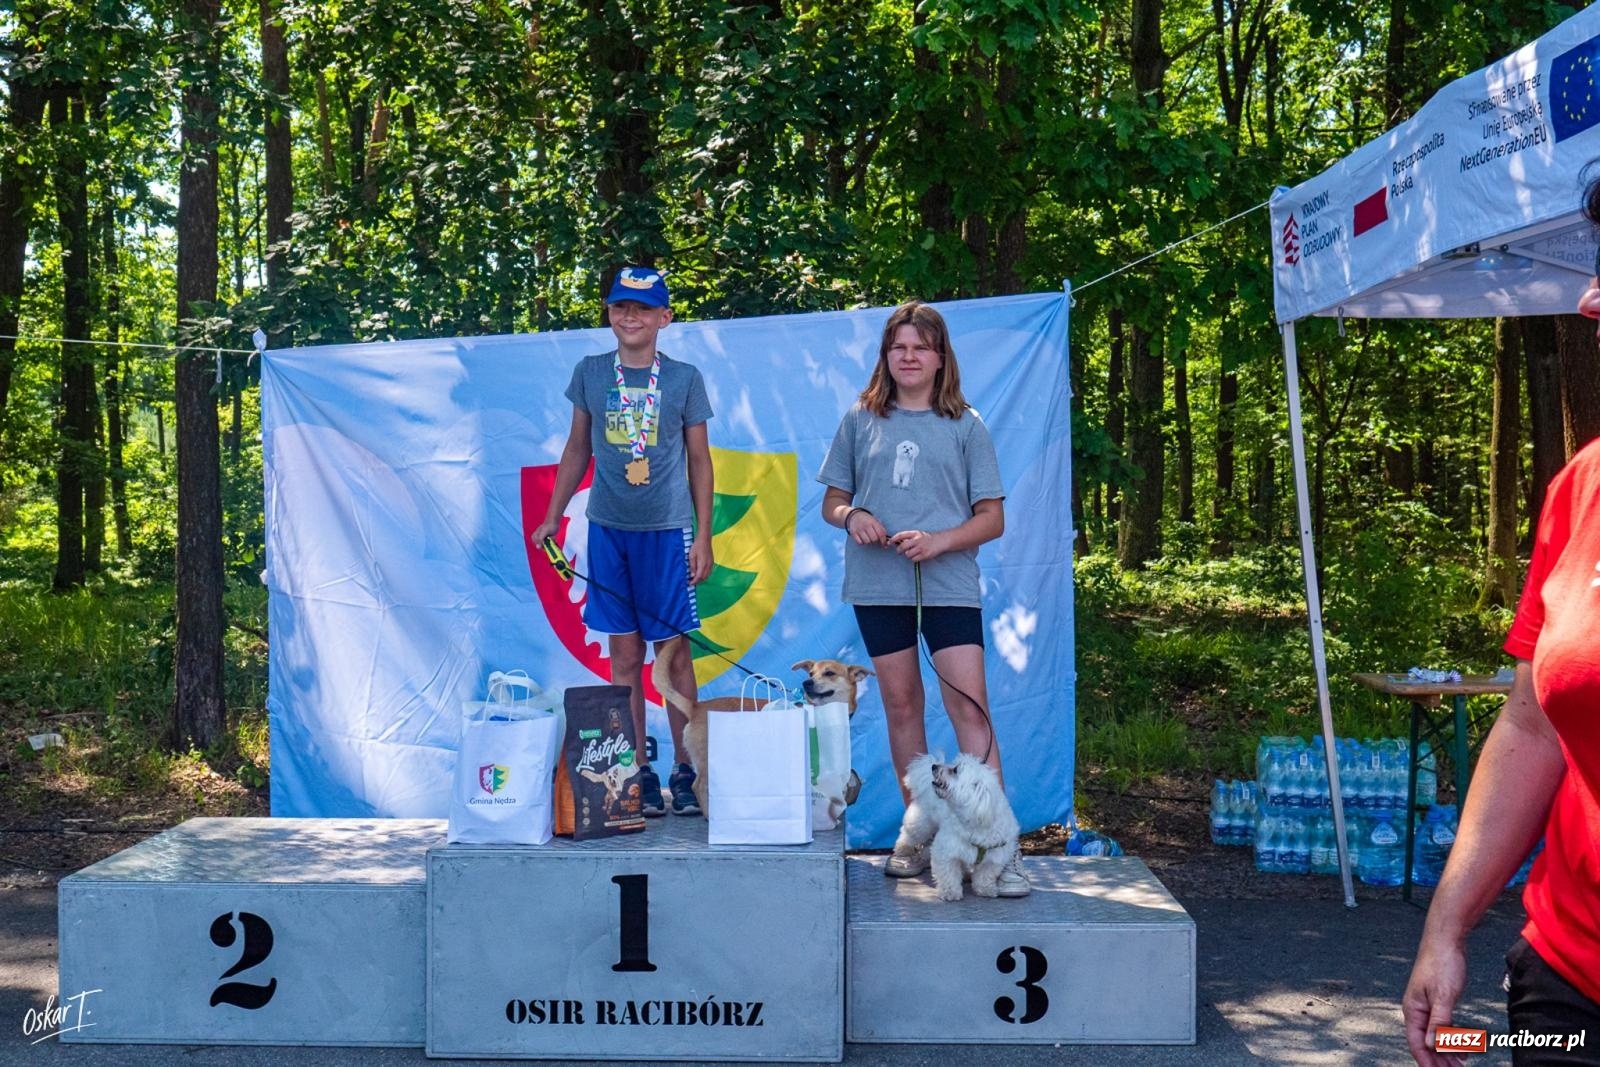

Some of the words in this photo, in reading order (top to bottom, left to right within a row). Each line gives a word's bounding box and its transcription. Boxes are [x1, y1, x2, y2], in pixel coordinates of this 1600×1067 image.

[1468, 86, 1516, 120] Sfinansowane
[1517, 74, 1541, 99] przez
[1482, 120, 1500, 139] Unię
[1502, 101, 1542, 131] Europejską
[1392, 132, 1445, 177] Rzeczpospolita
[1460, 123, 1547, 173] NextGenerationEU
[1302, 190, 1329, 219] KRAJOWY
[1391, 176, 1413, 199] Polska
[1301, 218, 1318, 239] PLAN
[1303, 226, 1341, 258] ODBUDOWY
[576, 733, 630, 772] Lifestyle
[470, 797, 493, 805] Gmina
[495, 797, 516, 805] Nędza
[611, 874, 657, 972] 1
[209, 911, 277, 1010] 2
[993, 945, 1049, 1024] 3
[505, 999, 585, 1025] OSIR
[595, 995, 764, 1027] RACIBÓRZ
